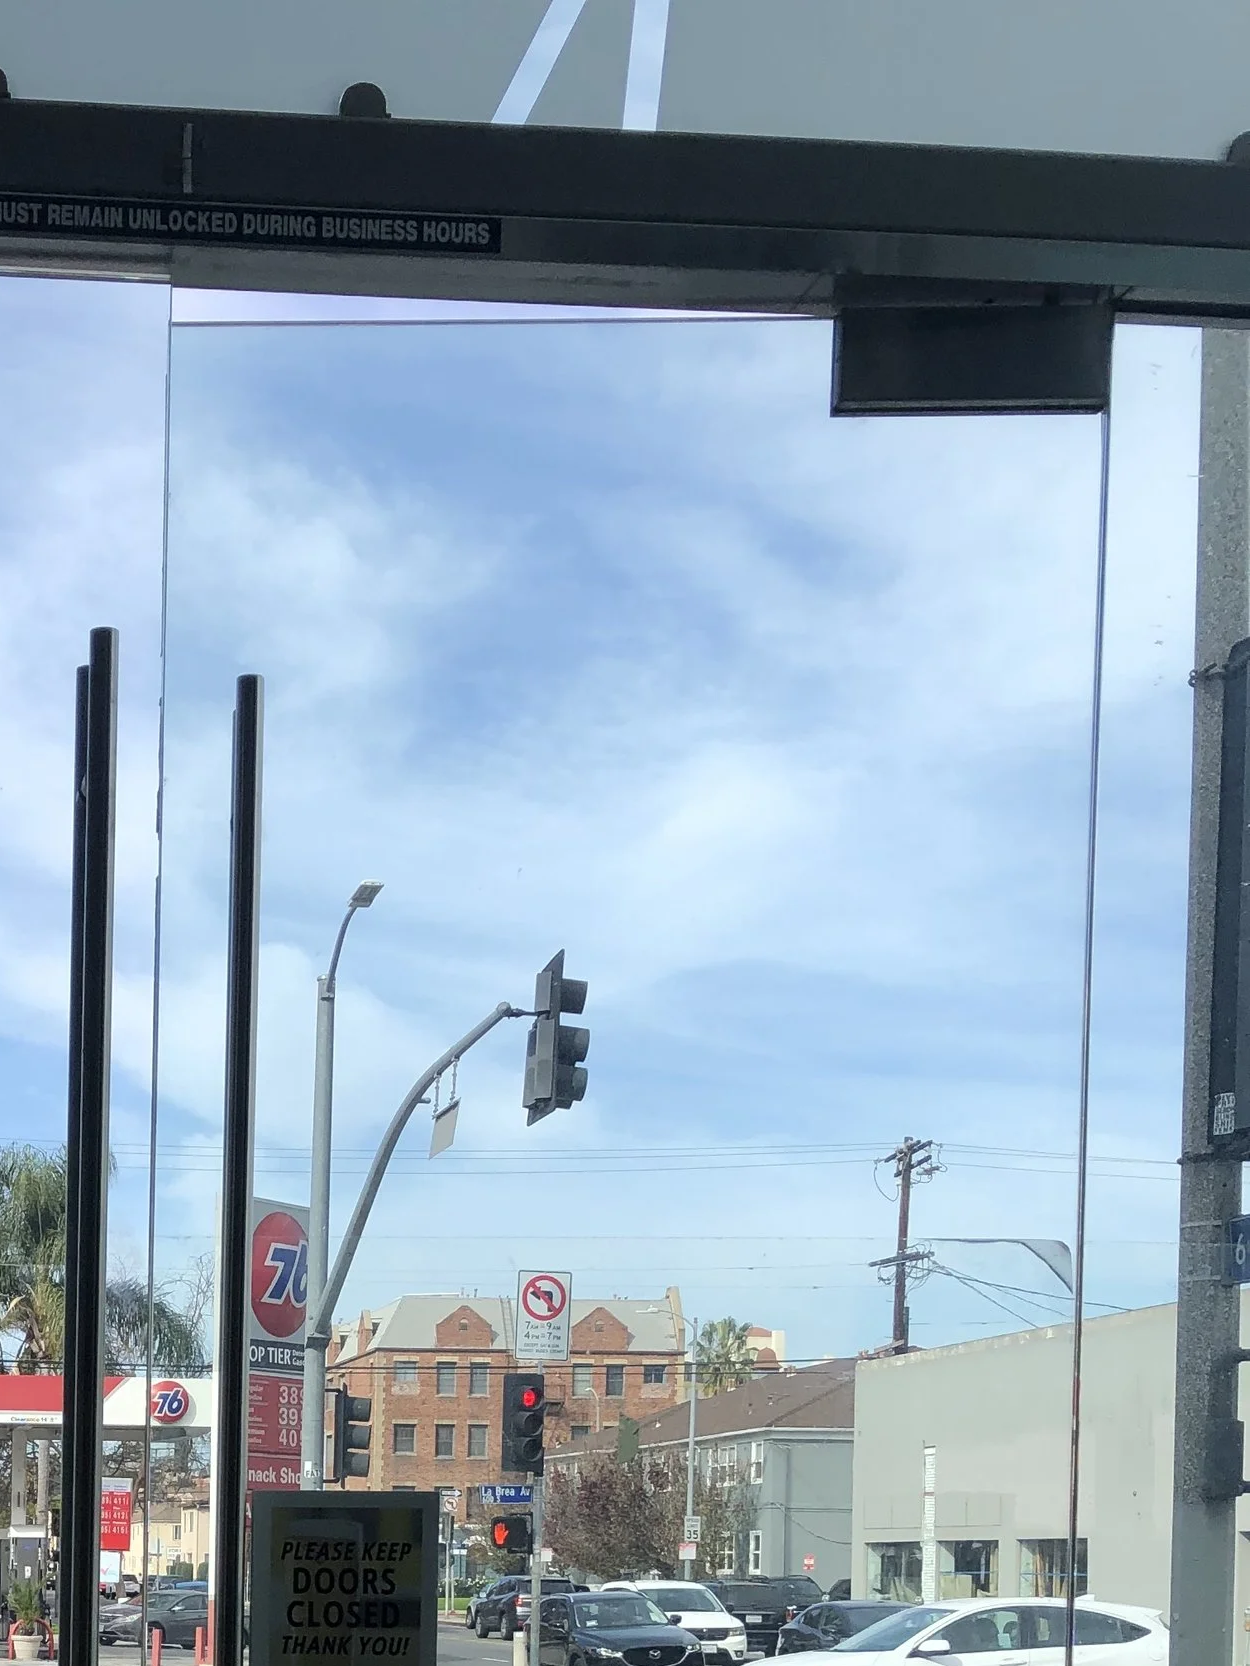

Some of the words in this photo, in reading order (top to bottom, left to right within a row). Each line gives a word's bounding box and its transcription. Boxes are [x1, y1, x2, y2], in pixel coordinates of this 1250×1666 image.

[48, 204, 123, 228] REMAIN
[128, 208, 238, 233] UNLOCKED
[242, 213, 316, 237] DURING
[322, 216, 418, 241] BUSINESS
[423, 221, 490, 244] HOURS
[250, 1345, 265, 1362] OP
[267, 1347, 291, 1365] TIER
[153, 1388, 185, 1417] 76
[278, 1407, 303, 1426] 39
[278, 1429, 303, 1447] 40
[248, 1467, 276, 1483] nack
[280, 1467, 300, 1484] Sho
[482, 1487, 491, 1496] La
[495, 1486, 515, 1497] Brea
[520, 1487, 530, 1496] Av
[686, 1529, 699, 1539] 35
[281, 1542, 355, 1561] PLEASE
[361, 1542, 413, 1561] KEEP
[292, 1567, 396, 1595] DOORS
[286, 1600, 400, 1628] CLOSED
[282, 1636, 351, 1655] THANK
[359, 1636, 410, 1656] YOU!
